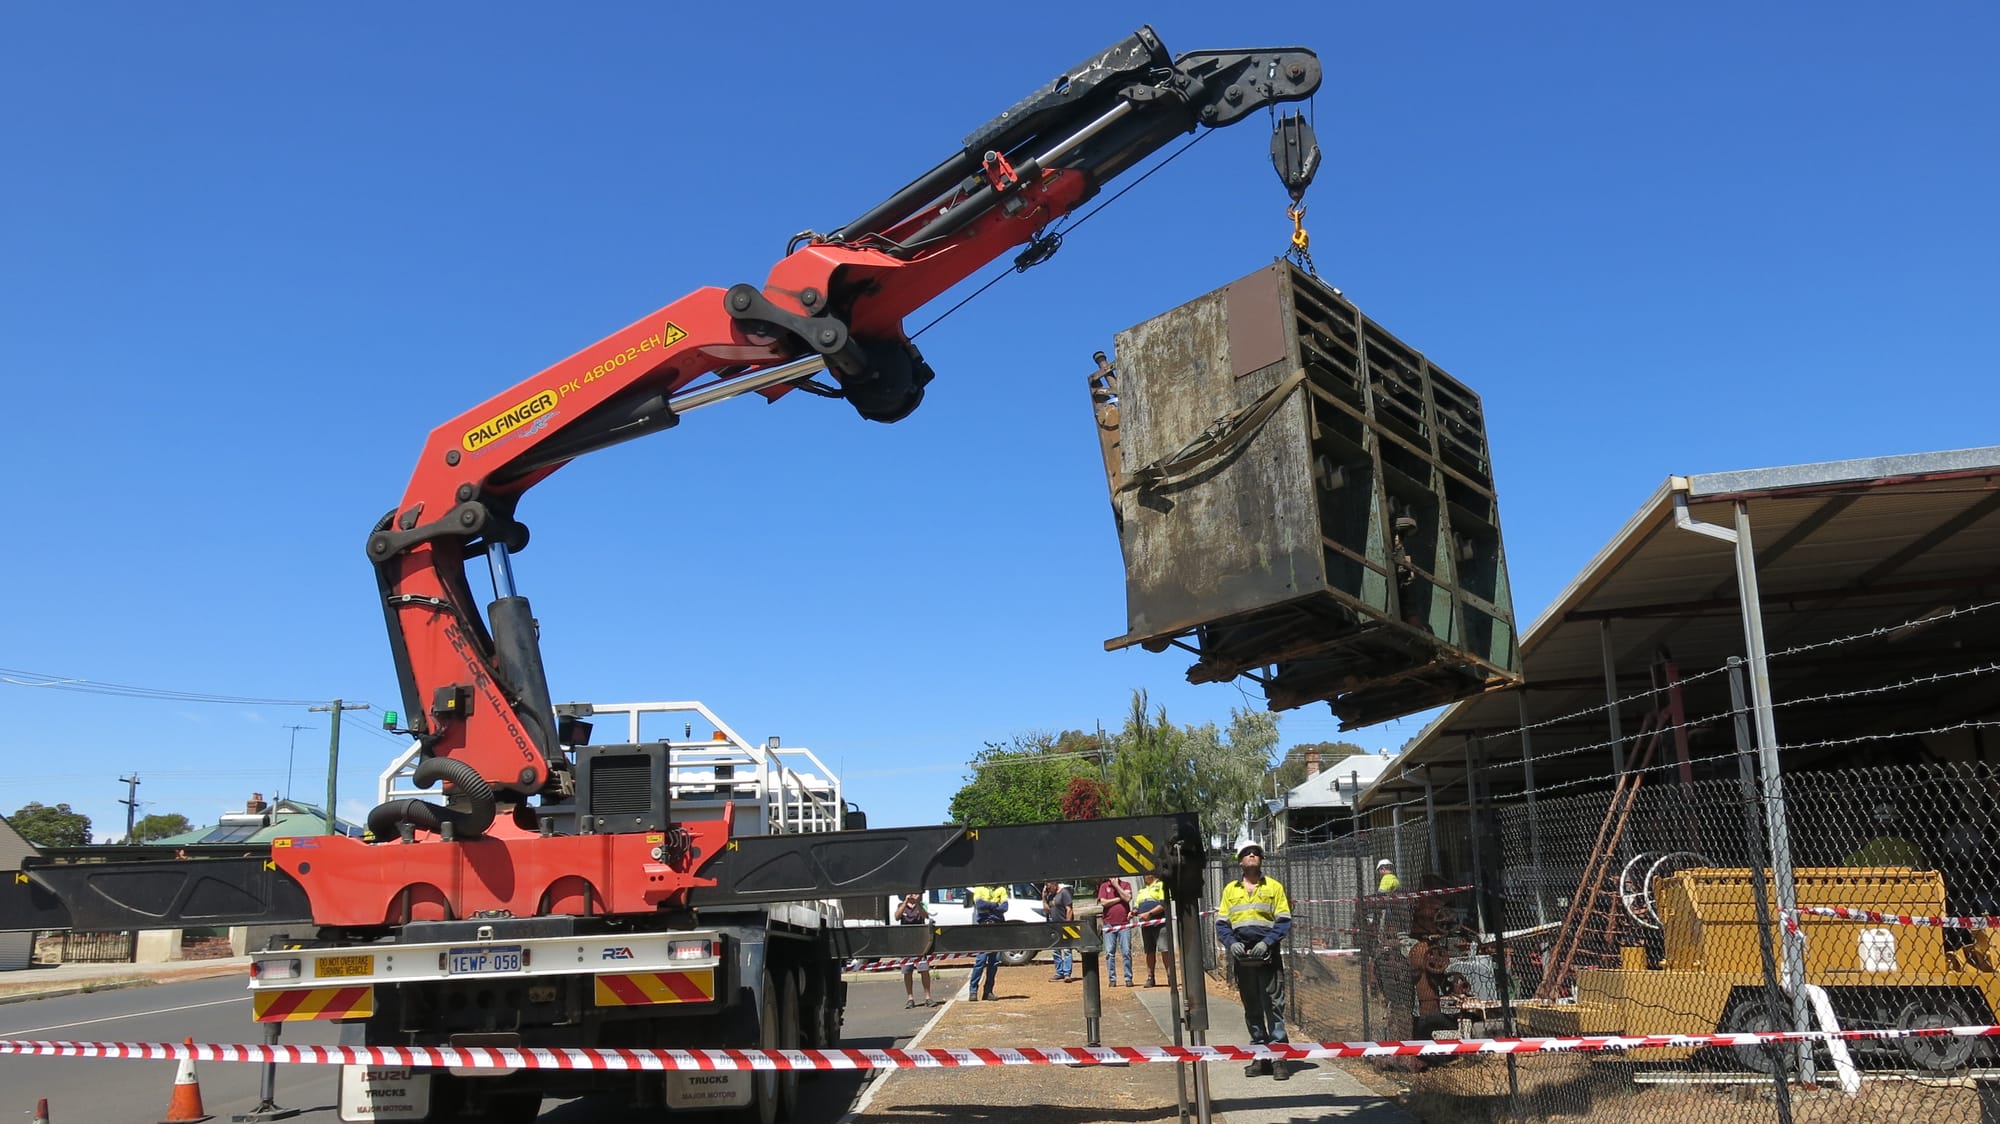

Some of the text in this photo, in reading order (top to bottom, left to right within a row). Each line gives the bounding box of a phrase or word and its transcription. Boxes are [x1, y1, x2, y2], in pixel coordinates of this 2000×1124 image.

[559, 333, 662, 398] PK 48002-EH
[468, 394, 553, 448] PALFINGER
[602, 946, 635, 960] REA
[340, 955, 369, 966] OVERTAKE
[345, 965, 369, 975] VEHICLE
[361, 1069, 412, 1083] ISUZU
[688, 1075, 729, 1085] TRUCKS
[365, 1089, 406, 1098] TRUCKS
[707, 1091, 737, 1099] MOTORS
[357, 1104, 413, 1113] MAJOR MOTORS
